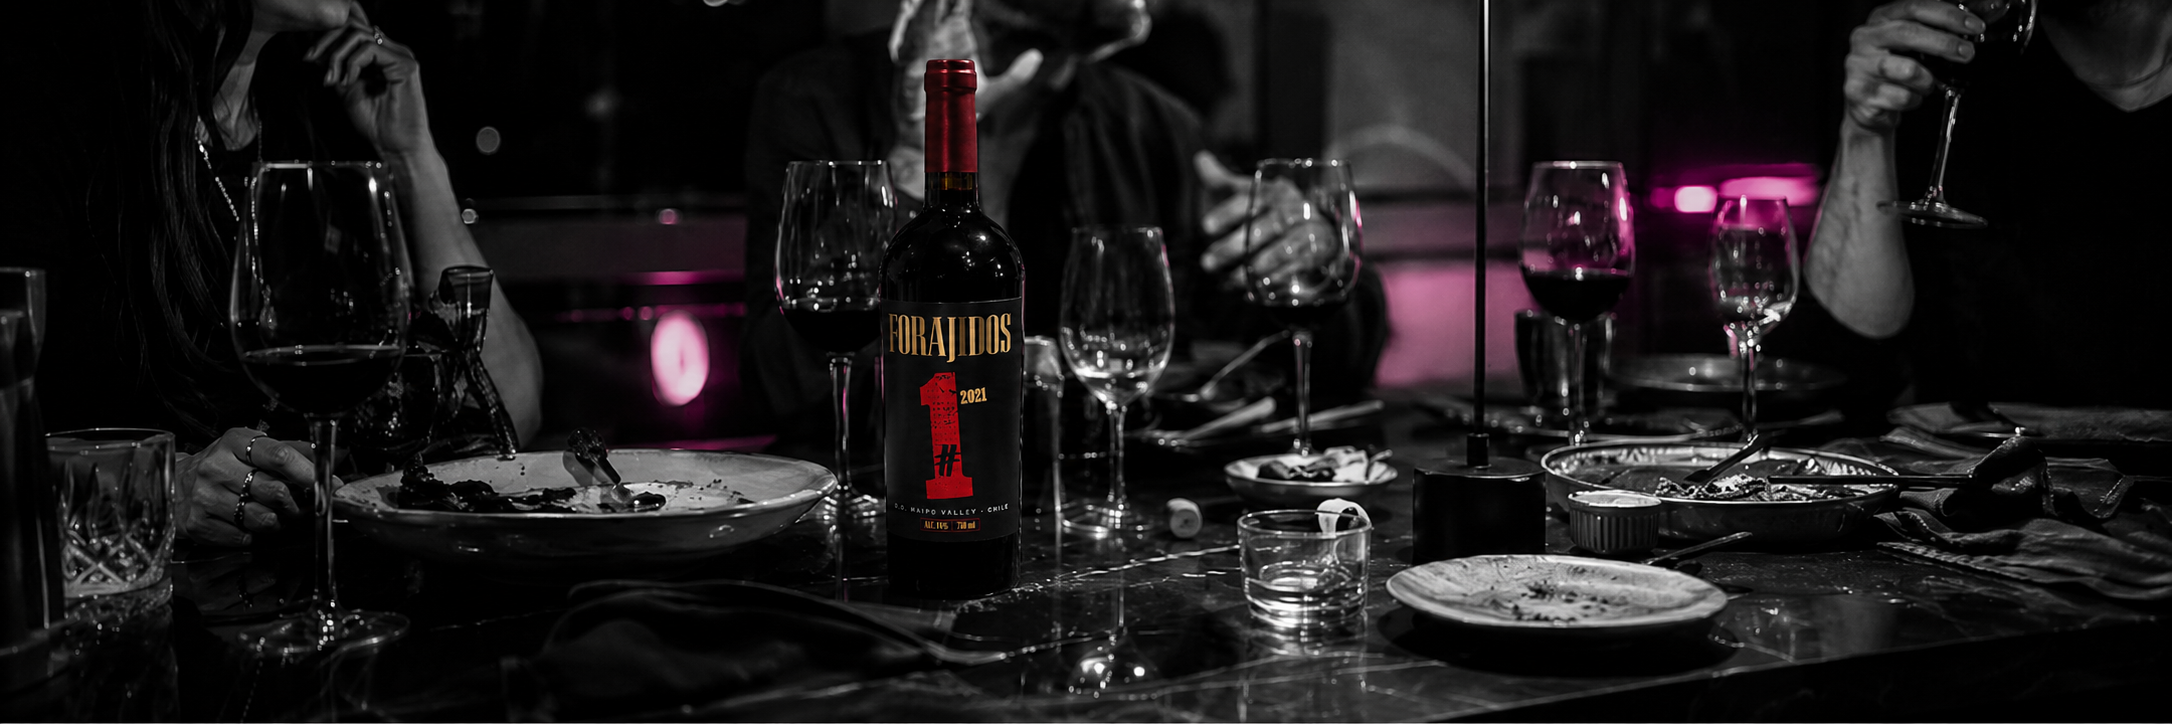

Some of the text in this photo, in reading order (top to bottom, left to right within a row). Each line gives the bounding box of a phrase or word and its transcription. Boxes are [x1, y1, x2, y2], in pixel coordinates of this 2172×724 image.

[888, 312, 1012, 363] FORAJIDOS
[959, 386, 988, 405] 2021
[919, 371, 974, 500] 1
[940, 507, 977, 516] VALLEY
[986, 502, 1009, 513] CHILE
